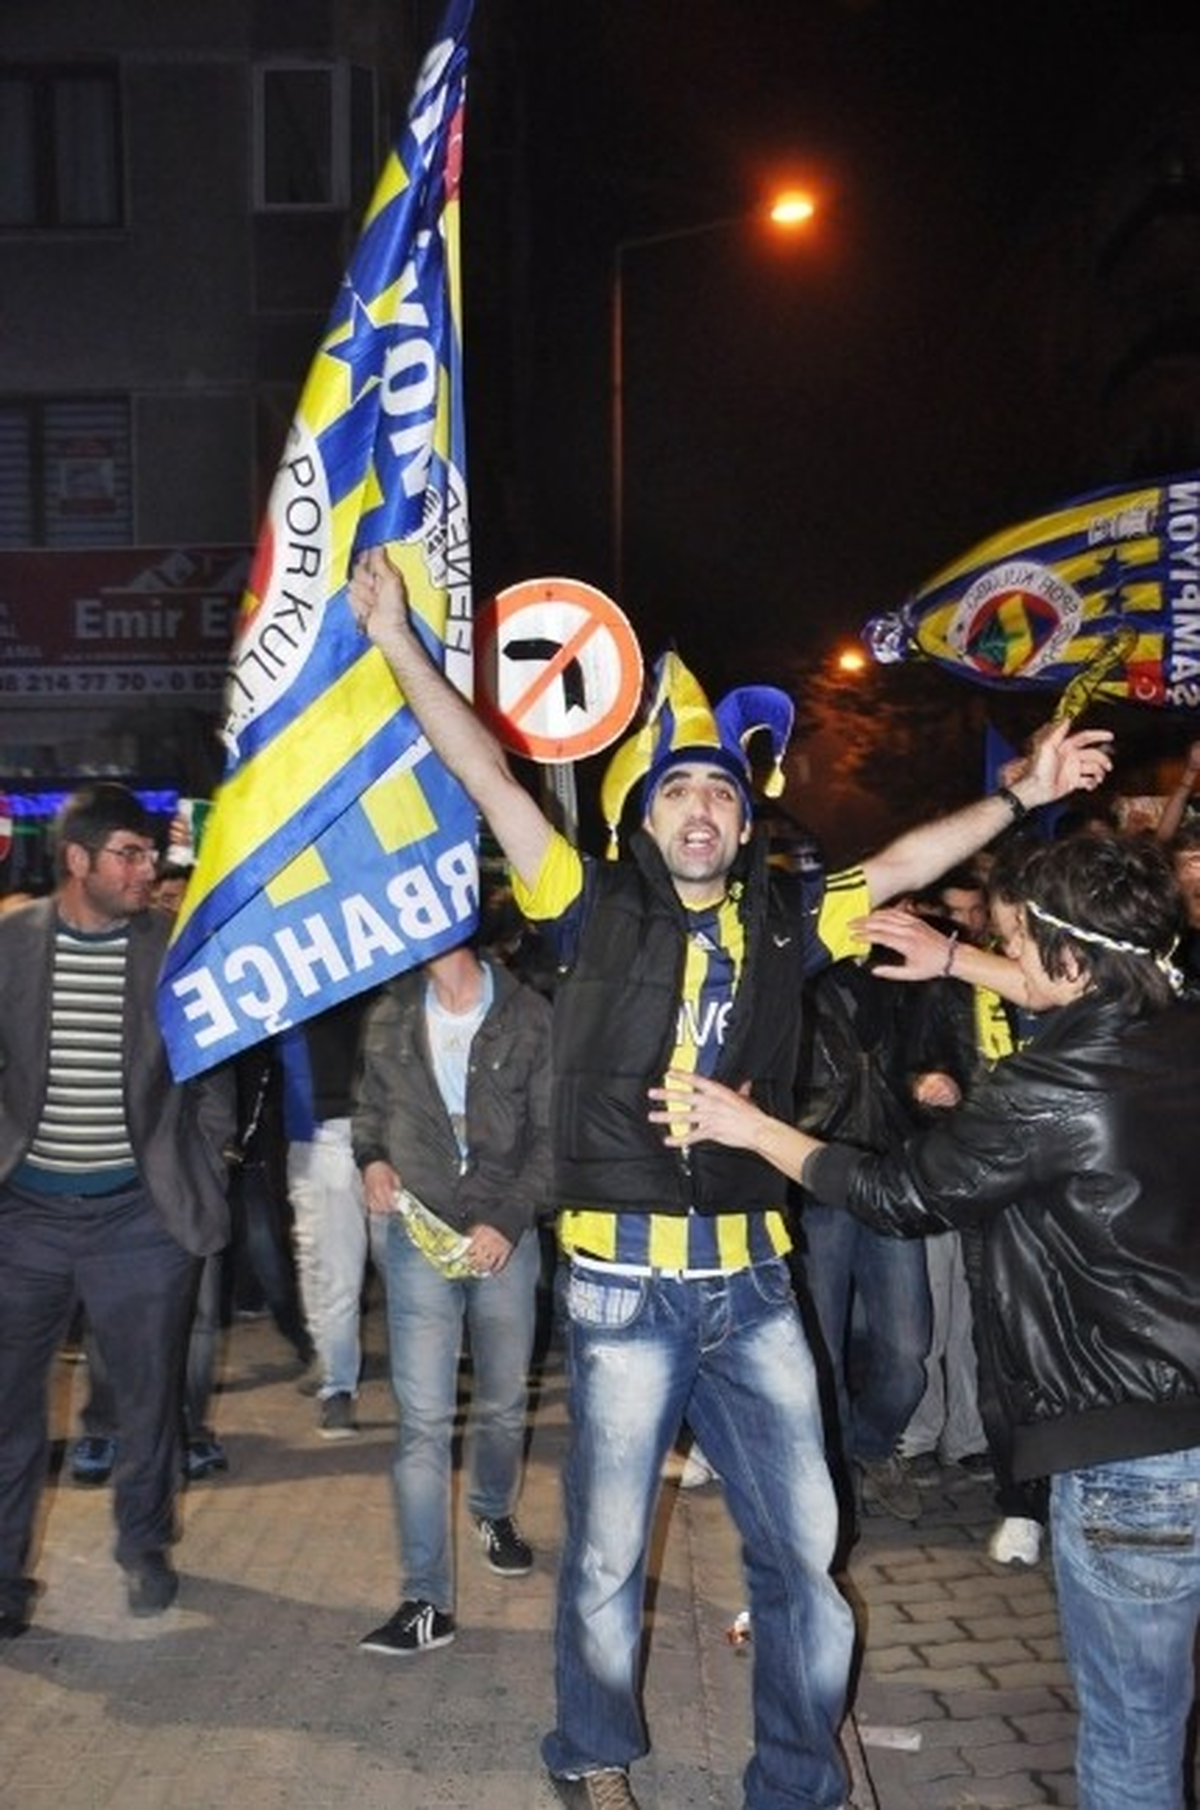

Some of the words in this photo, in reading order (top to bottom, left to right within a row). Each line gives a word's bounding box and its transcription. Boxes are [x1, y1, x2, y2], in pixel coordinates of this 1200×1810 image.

[370, 232, 436, 498] YON
[283, 432, 322, 579] POR
[75, 598, 184, 639] Emir
